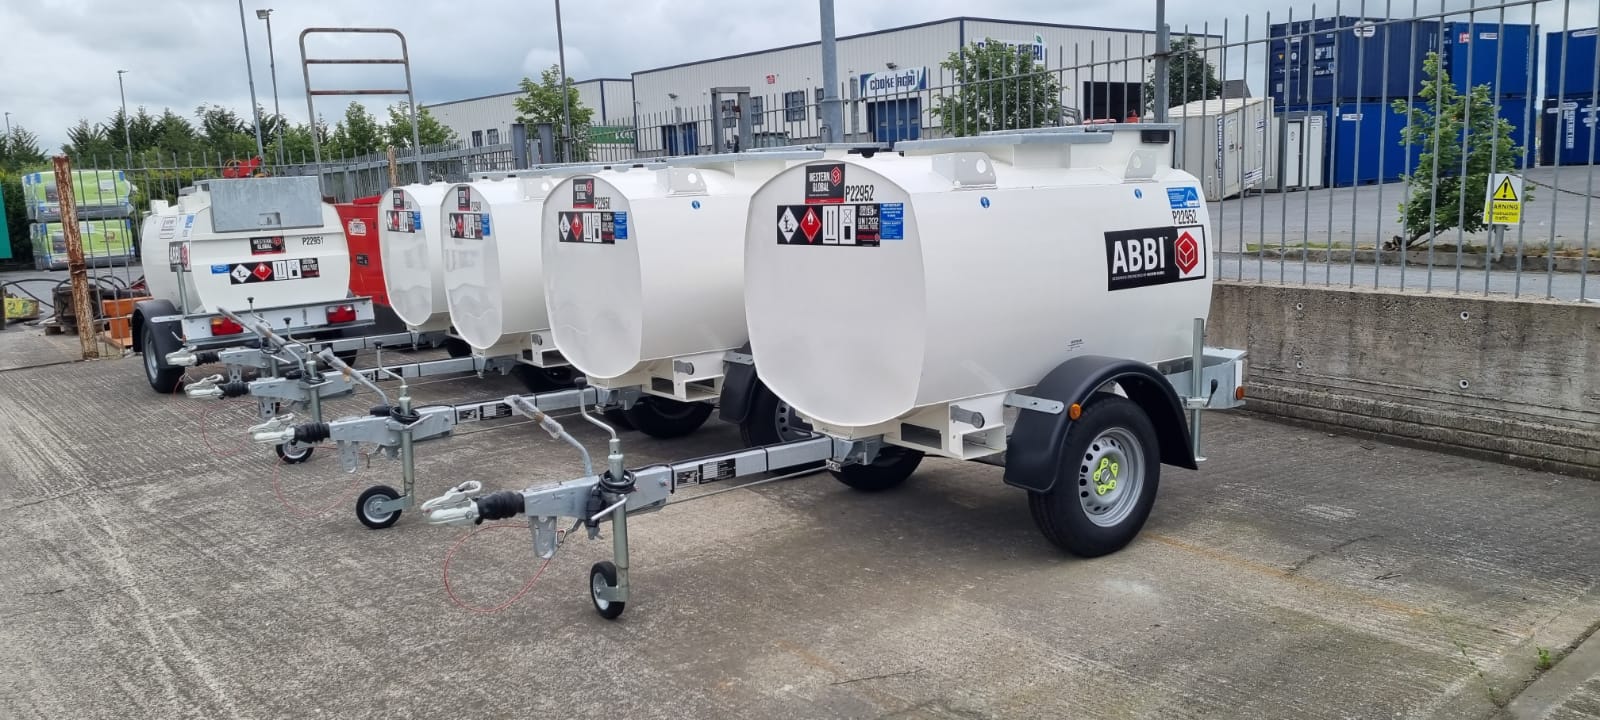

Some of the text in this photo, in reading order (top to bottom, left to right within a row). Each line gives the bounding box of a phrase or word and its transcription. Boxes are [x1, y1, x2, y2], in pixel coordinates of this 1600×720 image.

[869, 74, 916, 91] COOKE AGRI
[809, 171, 831, 182] WESTERN
[812, 182, 830, 192] GLOBAL
[846, 184, 874, 202] P22952
[1171, 209, 1198, 225] P22952
[1112, 236, 1165, 274] ABBI
